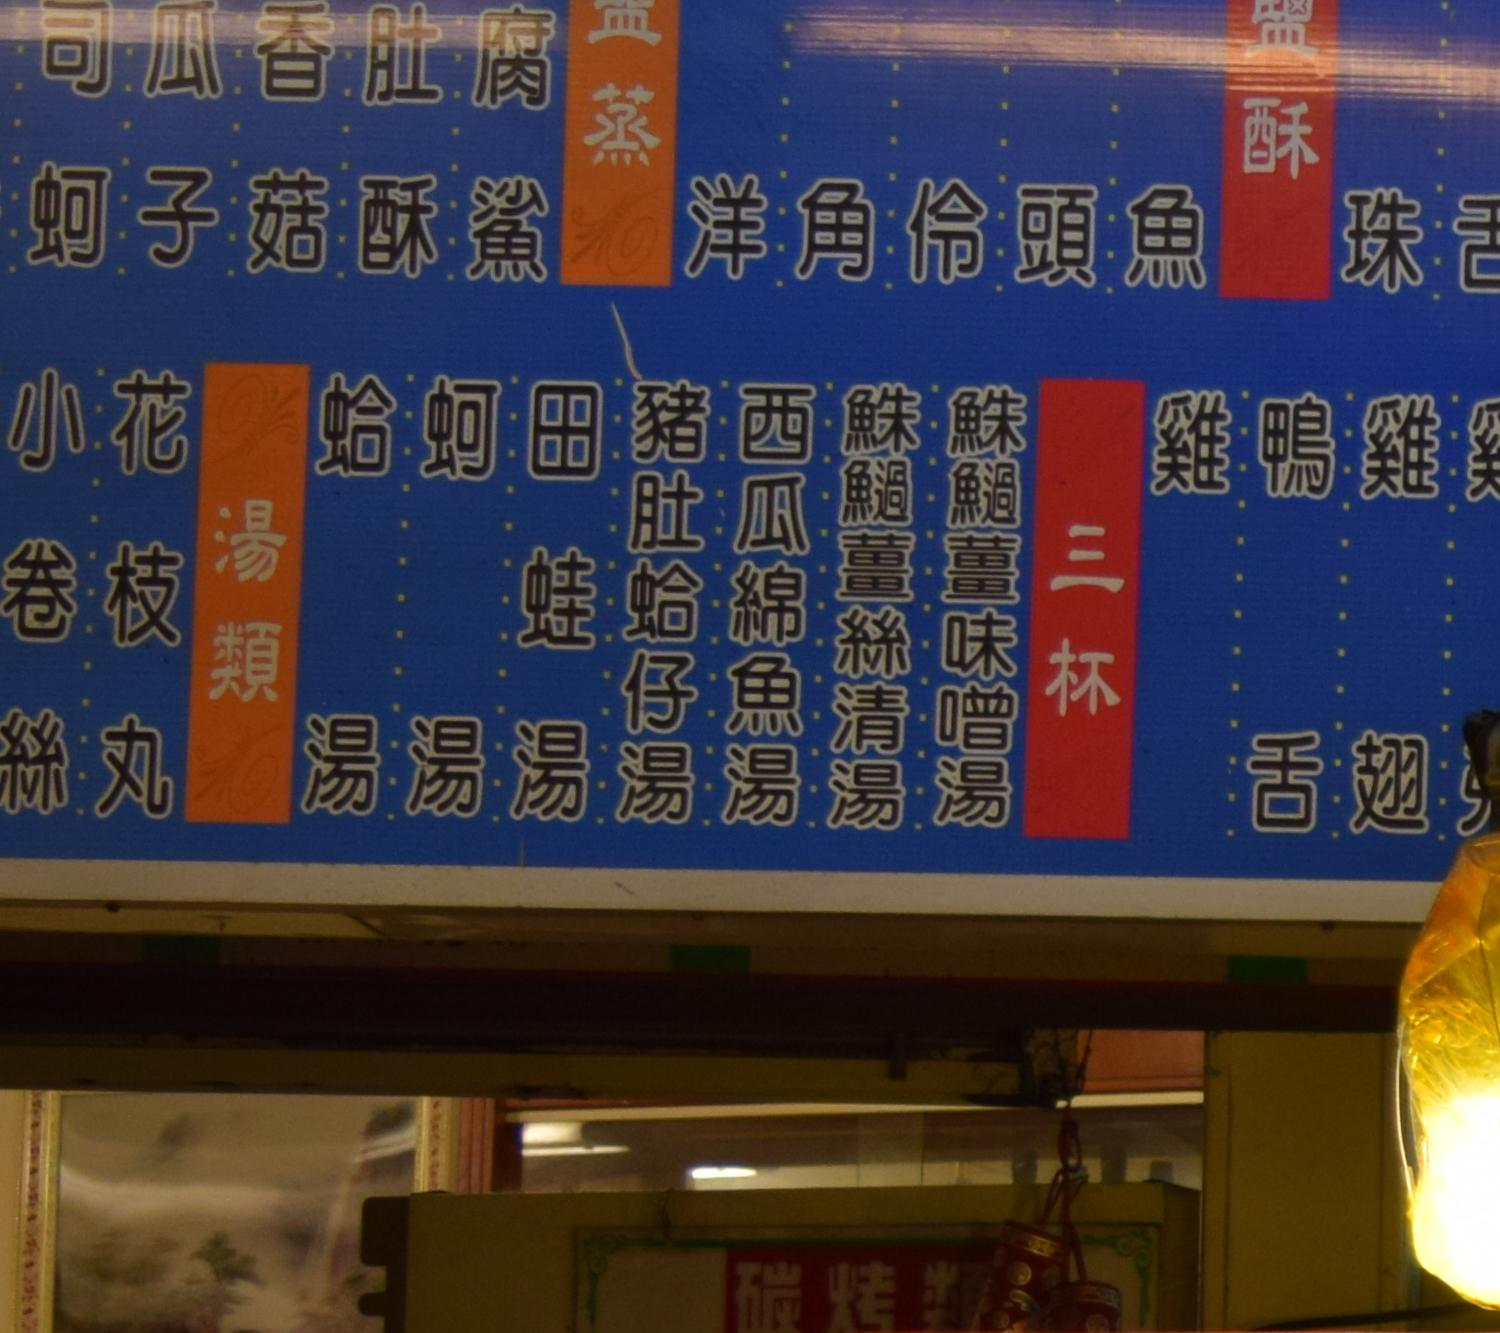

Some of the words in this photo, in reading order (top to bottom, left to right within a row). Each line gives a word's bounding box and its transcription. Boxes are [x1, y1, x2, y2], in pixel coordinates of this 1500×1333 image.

[246, 0, 337, 274] 香菇
[357, 3, 443, 279] 肚酥
[467, 5, 556, 283] 腐鯊
[684, 174, 770, 281] 洋
[795, 177, 874, 282] 角
[906, 178, 988, 285] 伶
[1014, 181, 1098, 288] 頭
[1123, 183, 1206, 289] 魚
[1341, 188, 1424, 291] 珠
[0, 367, 85, 816] 小卷絲
[95, 369, 192, 819] 花枝丸
[208, 498, 287, 703] 湯類
[509, 380, 603, 821] 田蛙湯
[615, 379, 710, 823] 豬肚蛤仔湯
[722, 380, 817, 826] 西瓜綿魚湯
[1043, 523, 1125, 718] 三杯
